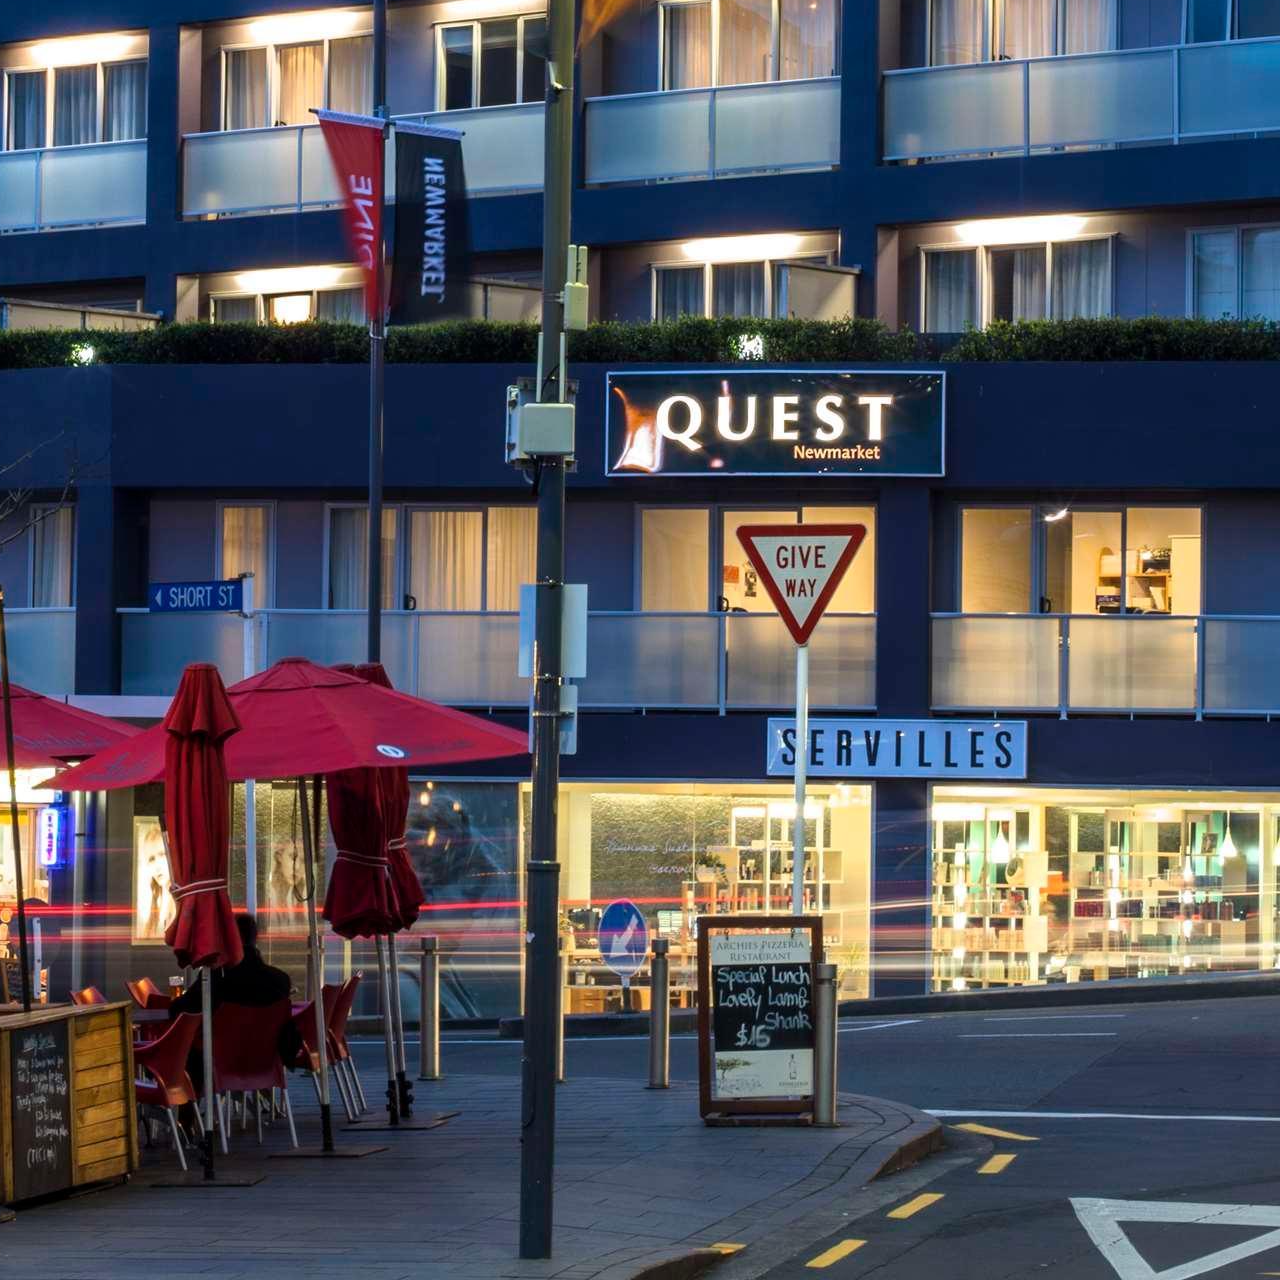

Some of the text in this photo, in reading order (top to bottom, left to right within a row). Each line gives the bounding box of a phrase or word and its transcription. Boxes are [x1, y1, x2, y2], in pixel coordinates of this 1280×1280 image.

[656, 395, 893, 451] QUEST
[793, 445, 881, 460] Newmarket
[776, 545, 826, 569] GIVE
[169, 585, 235, 608] SHORT ST
[785, 578, 817, 598] WAY
[782, 728, 1012, 768] SERVILLES
[717, 965, 810, 991] Special Lunch
[719, 986, 809, 1020] Lovely Lamb
[765, 1011, 813, 1030] Shank
